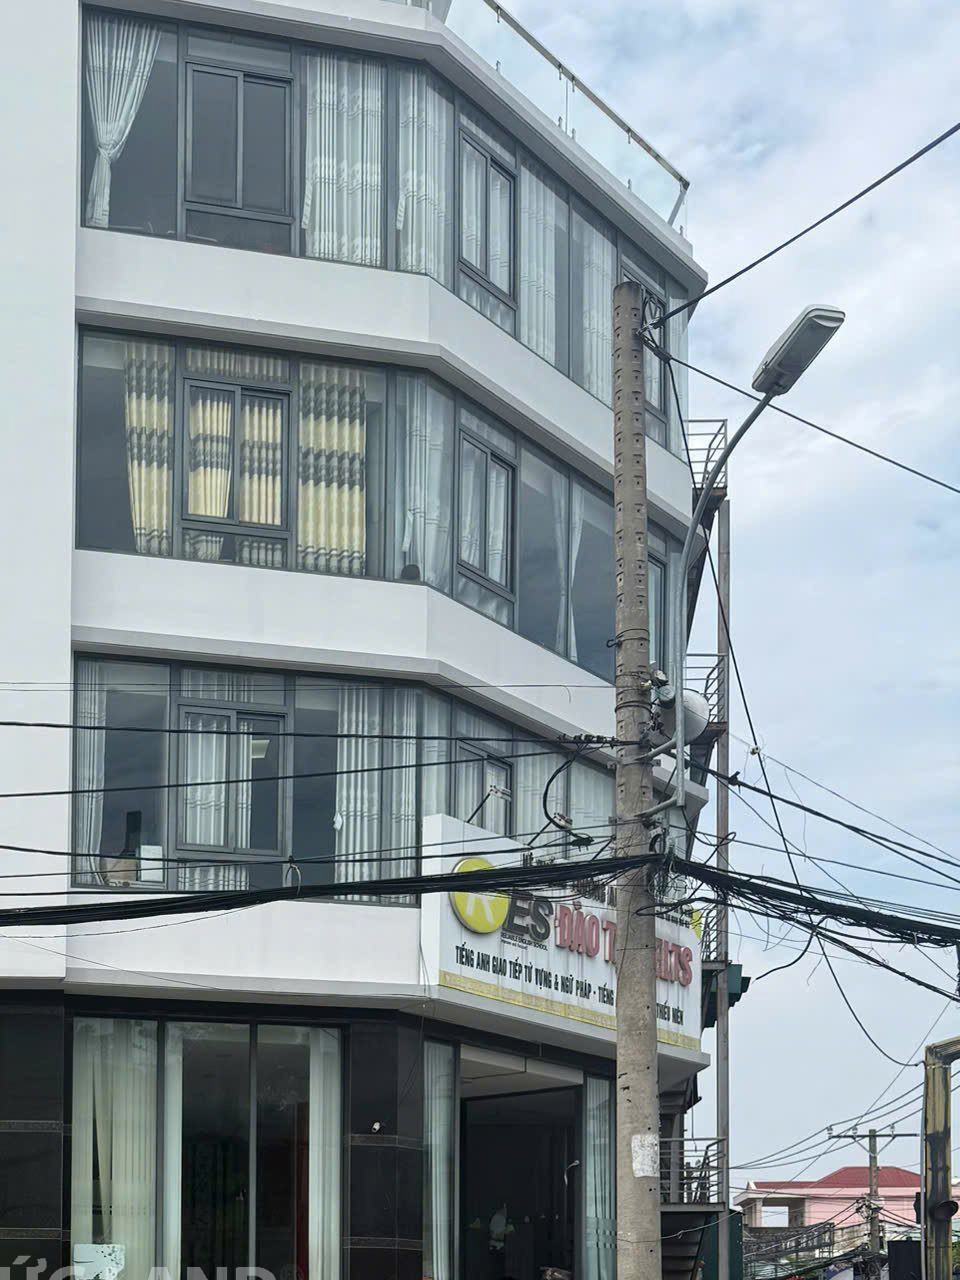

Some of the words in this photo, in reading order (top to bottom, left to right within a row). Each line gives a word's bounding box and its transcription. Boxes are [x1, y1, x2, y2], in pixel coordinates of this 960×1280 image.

[455, 942, 474, 968] TIẾNG
[476, 952, 490, 973] ANH
[492, 956, 507, 977] GIAO
[509, 957, 523, 980] TIẾP
